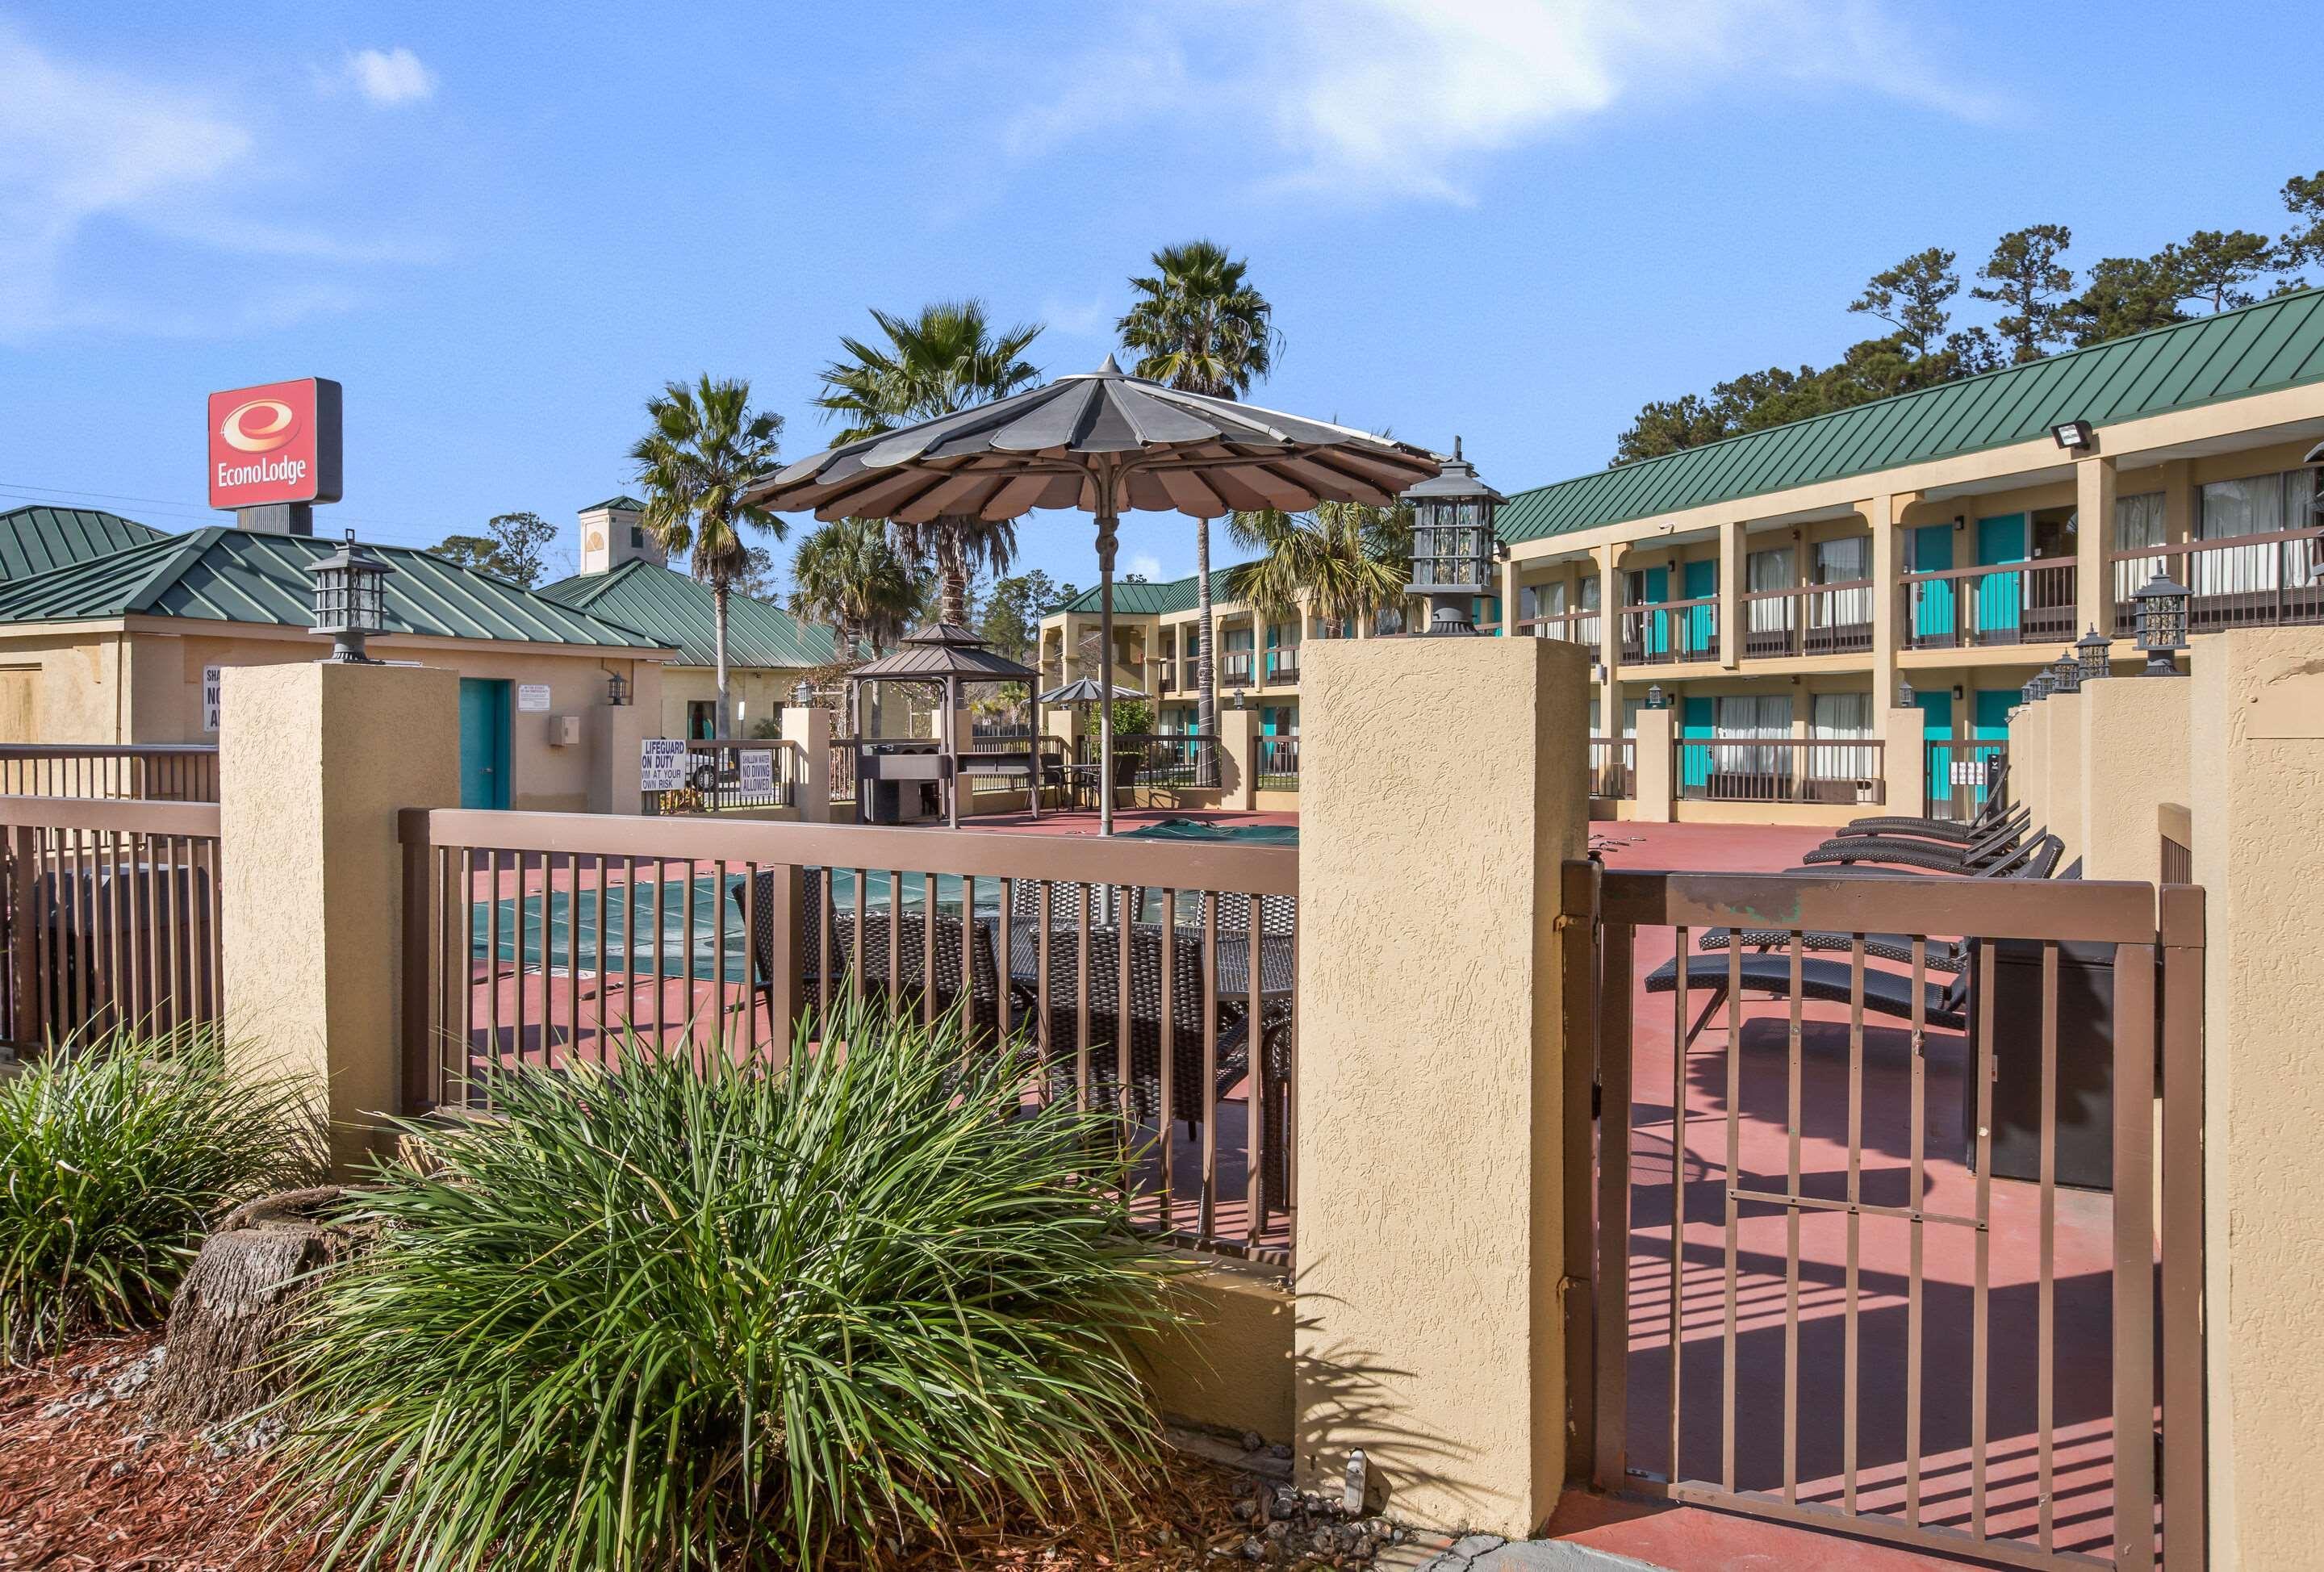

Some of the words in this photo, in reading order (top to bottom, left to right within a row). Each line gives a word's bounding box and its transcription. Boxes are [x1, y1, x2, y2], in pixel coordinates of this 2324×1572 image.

[218, 454, 307, 487] EconoLodge
[646, 741, 684, 755] LIFEGUARD
[642, 755, 652, 769] ON
[655, 755, 675, 769] DUTY
[653, 769, 661, 779] AT
[663, 769, 681, 779] YOUR
[742, 765, 750, 778] NO
[751, 764, 770, 777] DIVING
[642, 780, 656, 789] OWN
[658, 779, 673, 788] RISK
[742, 778, 770, 791] ALLOWED
